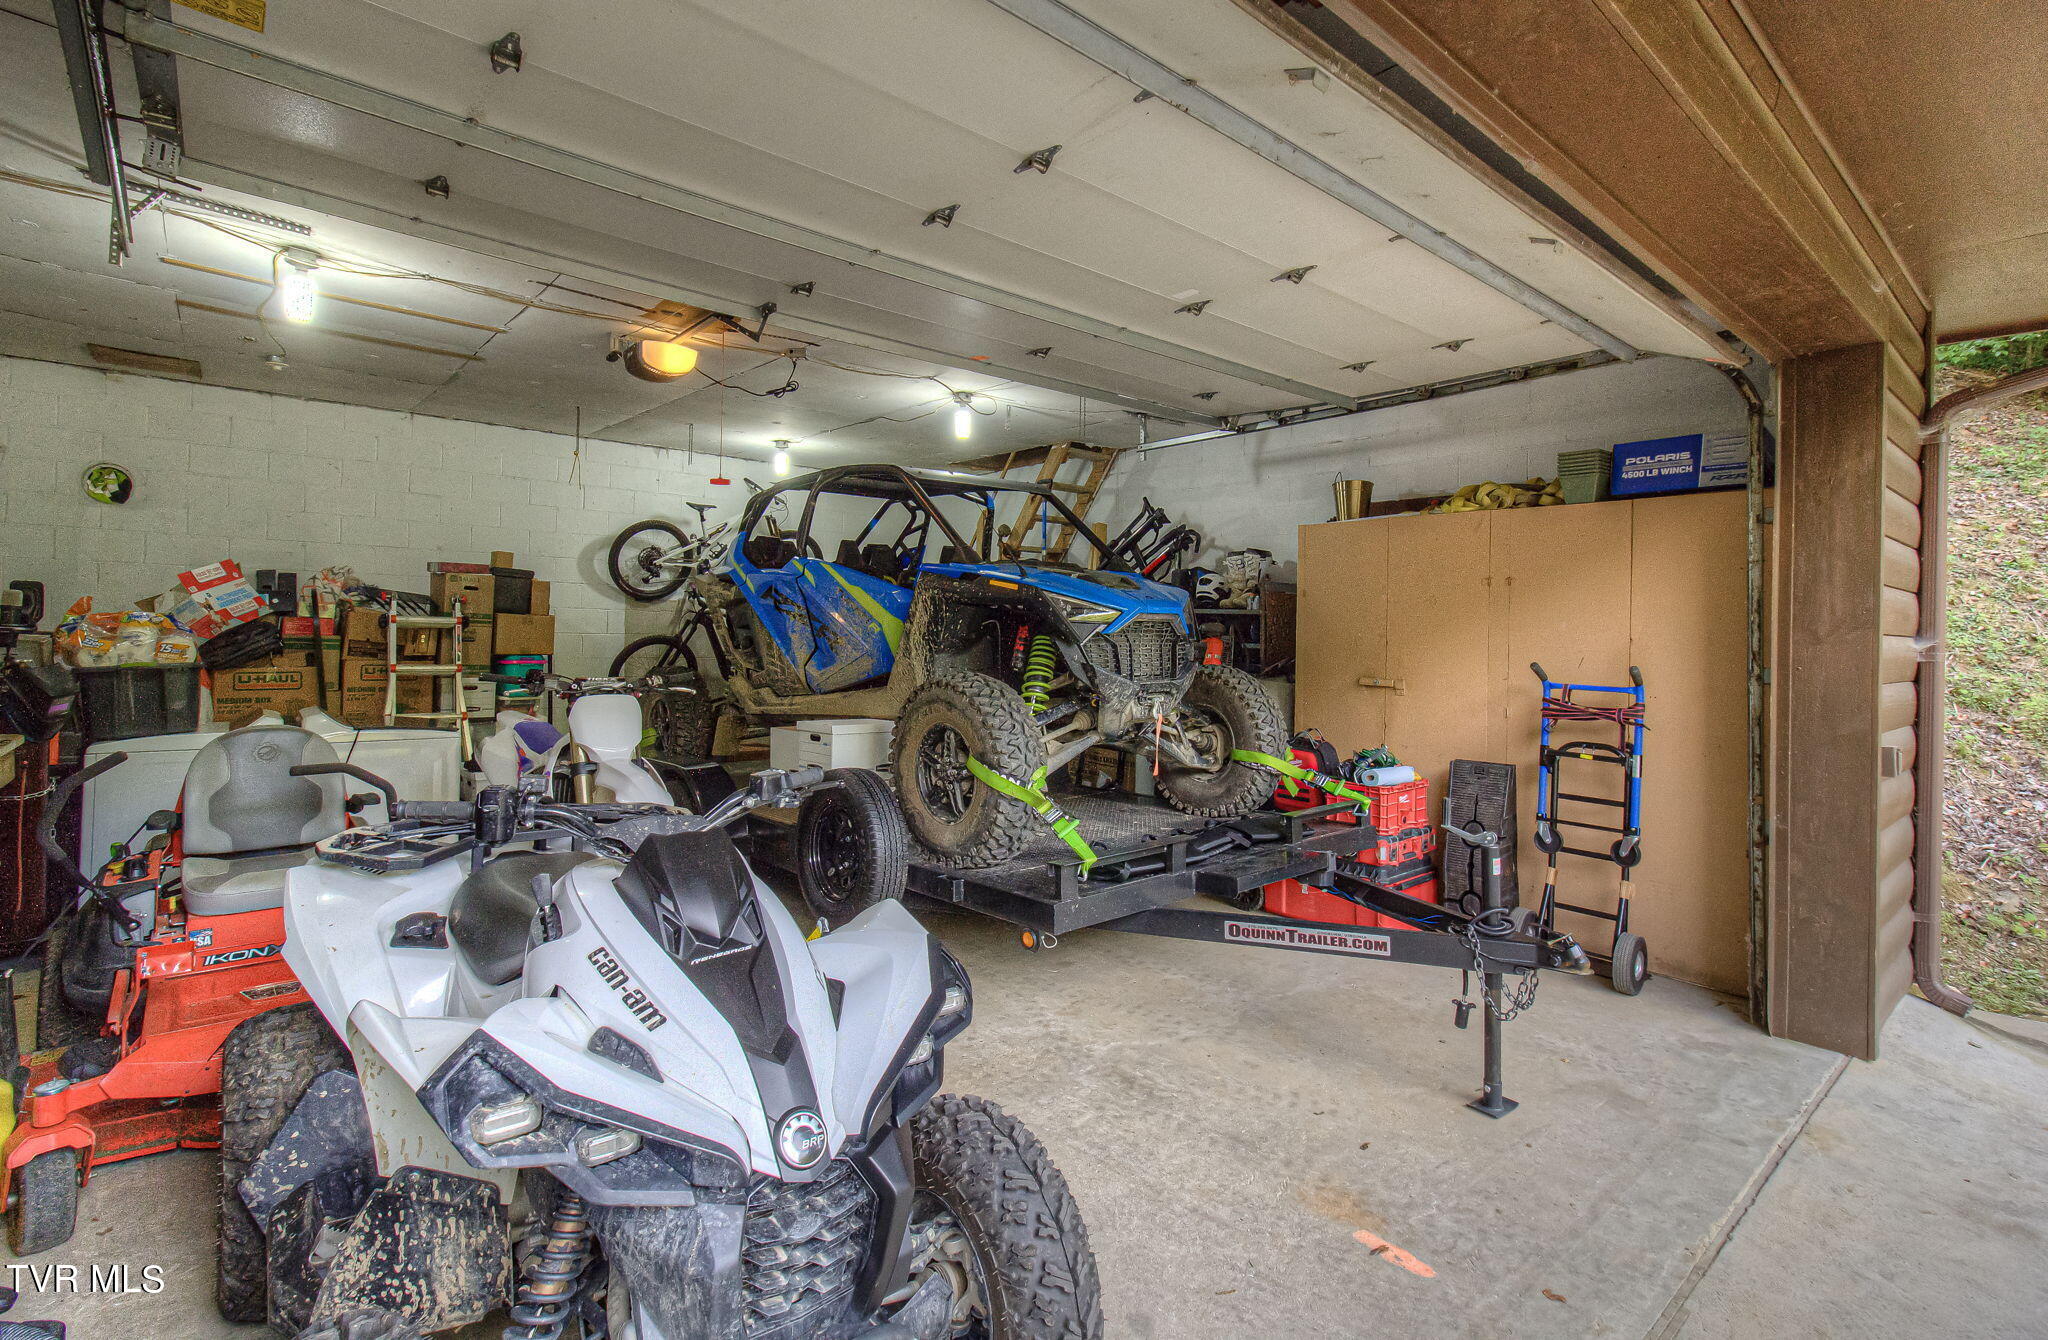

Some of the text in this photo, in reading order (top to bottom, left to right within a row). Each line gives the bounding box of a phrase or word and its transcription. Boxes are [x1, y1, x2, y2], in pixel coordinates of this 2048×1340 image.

[1625, 451, 1691, 465] POLARIS
[1646, 468, 1659, 477] LB
[1660, 465, 1693, 475] WINCH
[238, 674, 299, 684] U-HAUL
[217, 697, 252, 705] MEDIUM
[586, 946, 668, 1032] can-am
[801, 1134, 824, 1150] BRP
